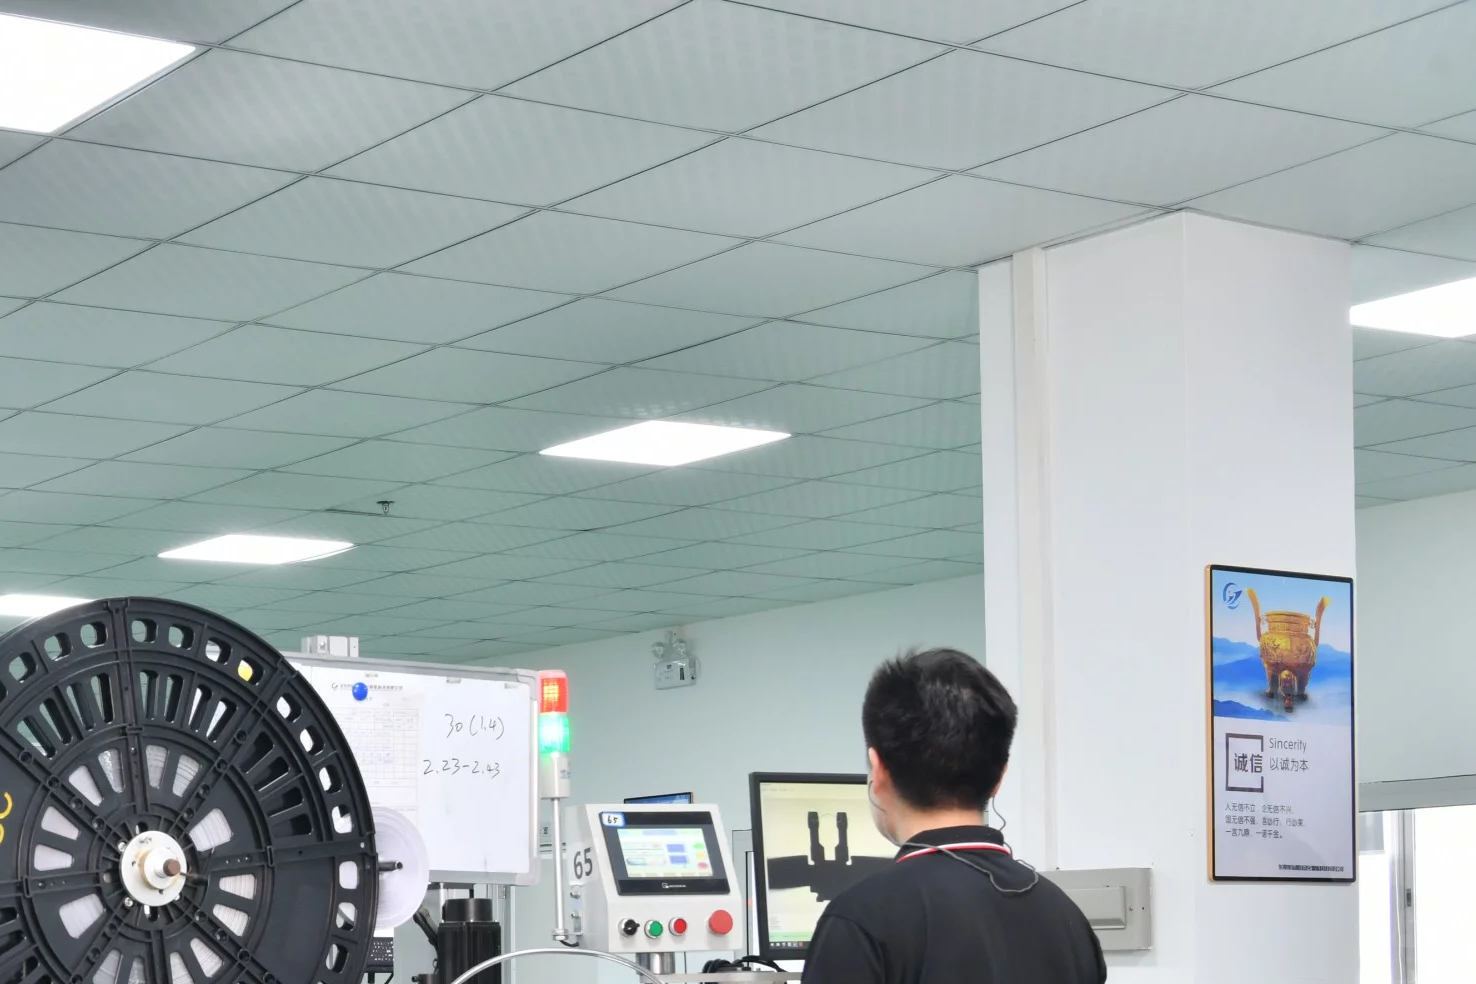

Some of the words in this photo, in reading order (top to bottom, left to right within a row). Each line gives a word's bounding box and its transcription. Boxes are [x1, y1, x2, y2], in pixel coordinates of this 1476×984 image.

[1269, 738, 1307, 754] Sincerity
[1233, 752, 1263, 774] 诚信
[1269, 757, 1309, 773] 以诚为本
[573, 847, 593, 880] 65
